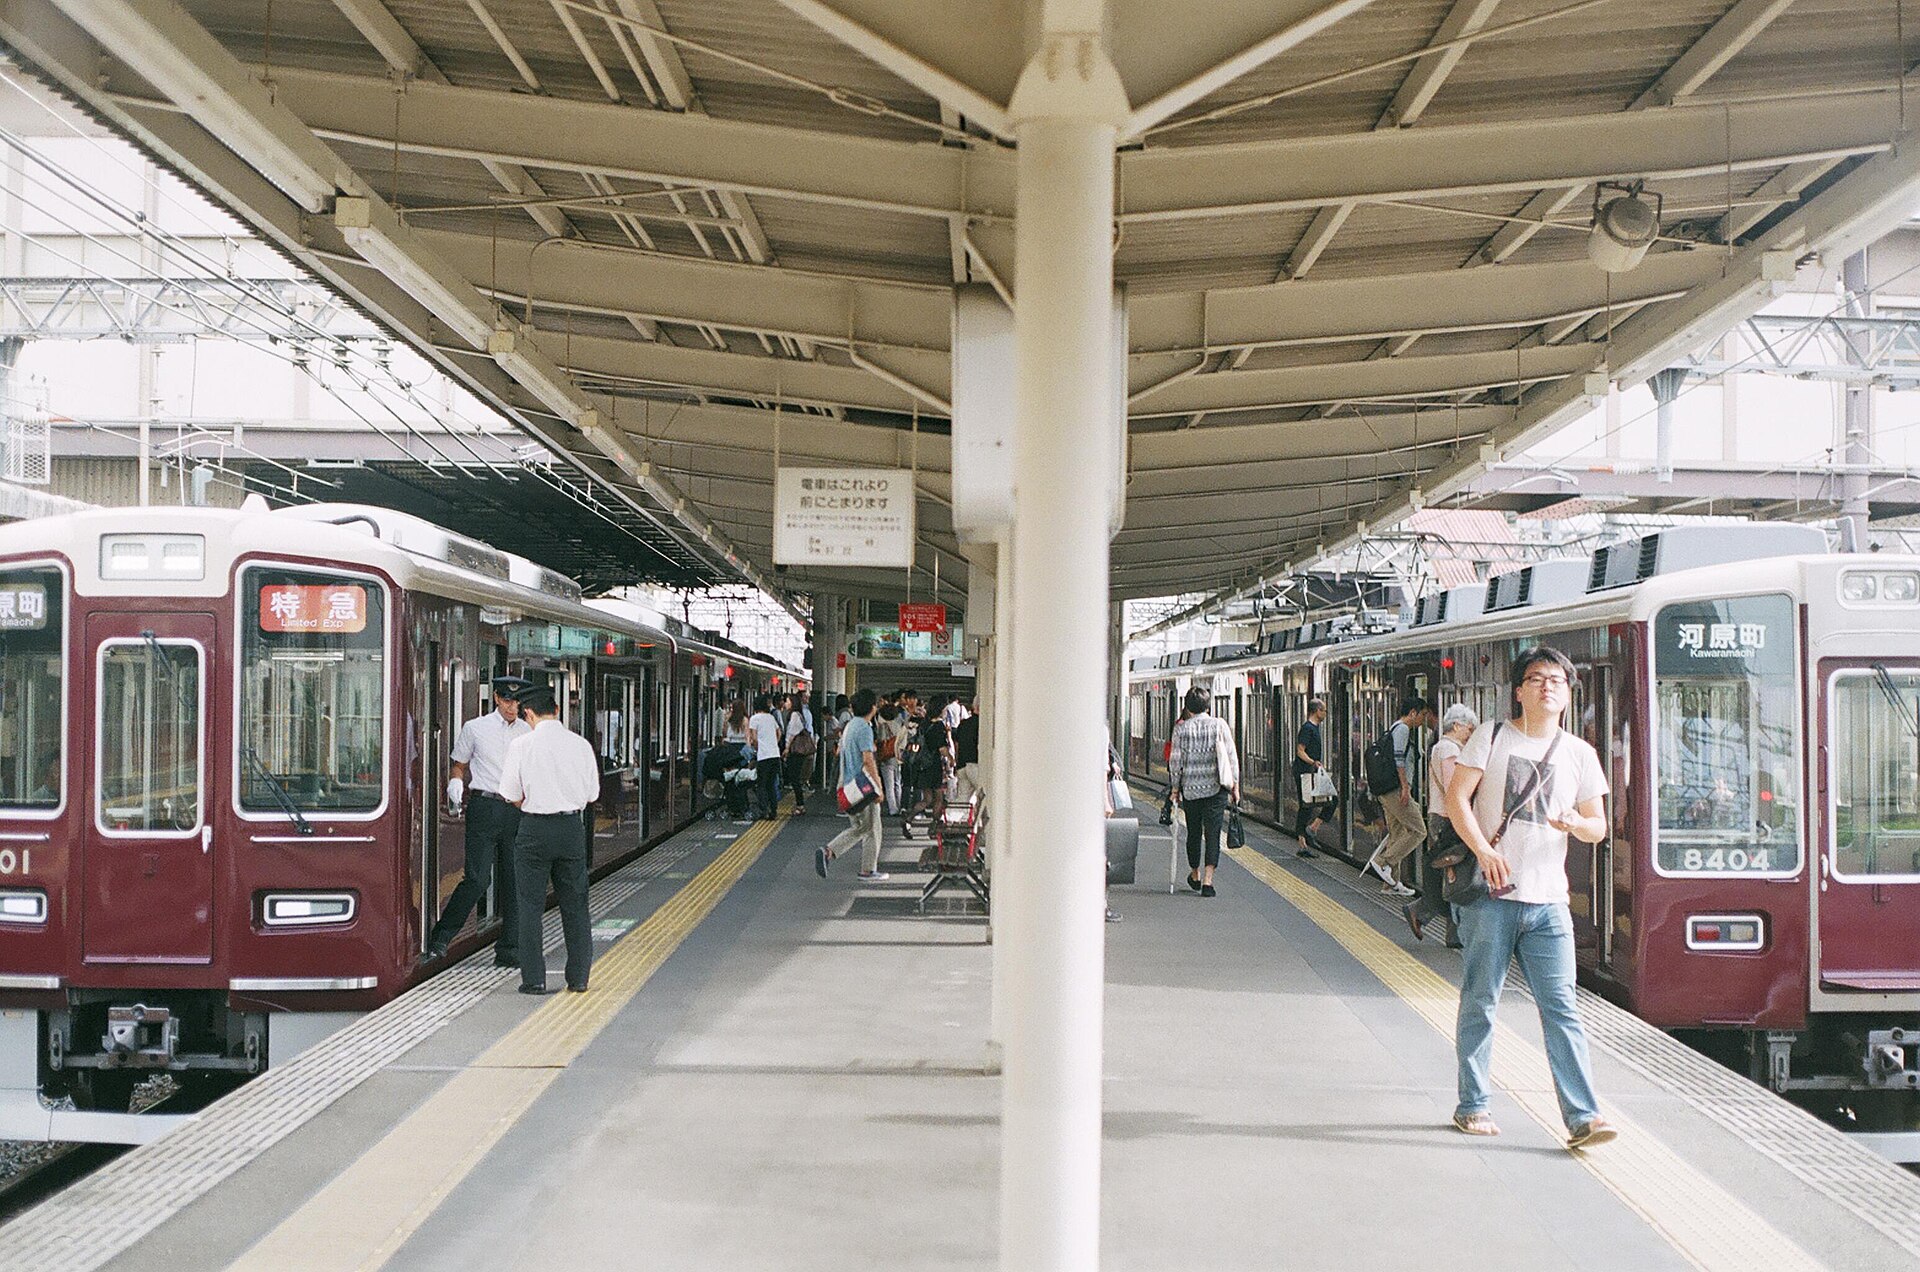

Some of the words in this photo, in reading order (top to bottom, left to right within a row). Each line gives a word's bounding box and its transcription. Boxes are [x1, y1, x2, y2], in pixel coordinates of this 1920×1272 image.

[801, 479, 888, 491] 電車はこれより
[801, 496, 888, 509] 前にとまります
[270, 591, 358, 619] 特急
[281, 619, 318, 627] Limited
[1678, 623, 1767, 649] 河原町
[1690, 648, 1755, 658] Kawaramachi
[0, 849, 30, 875] 01
[1683, 848, 1770, 871] 8404
